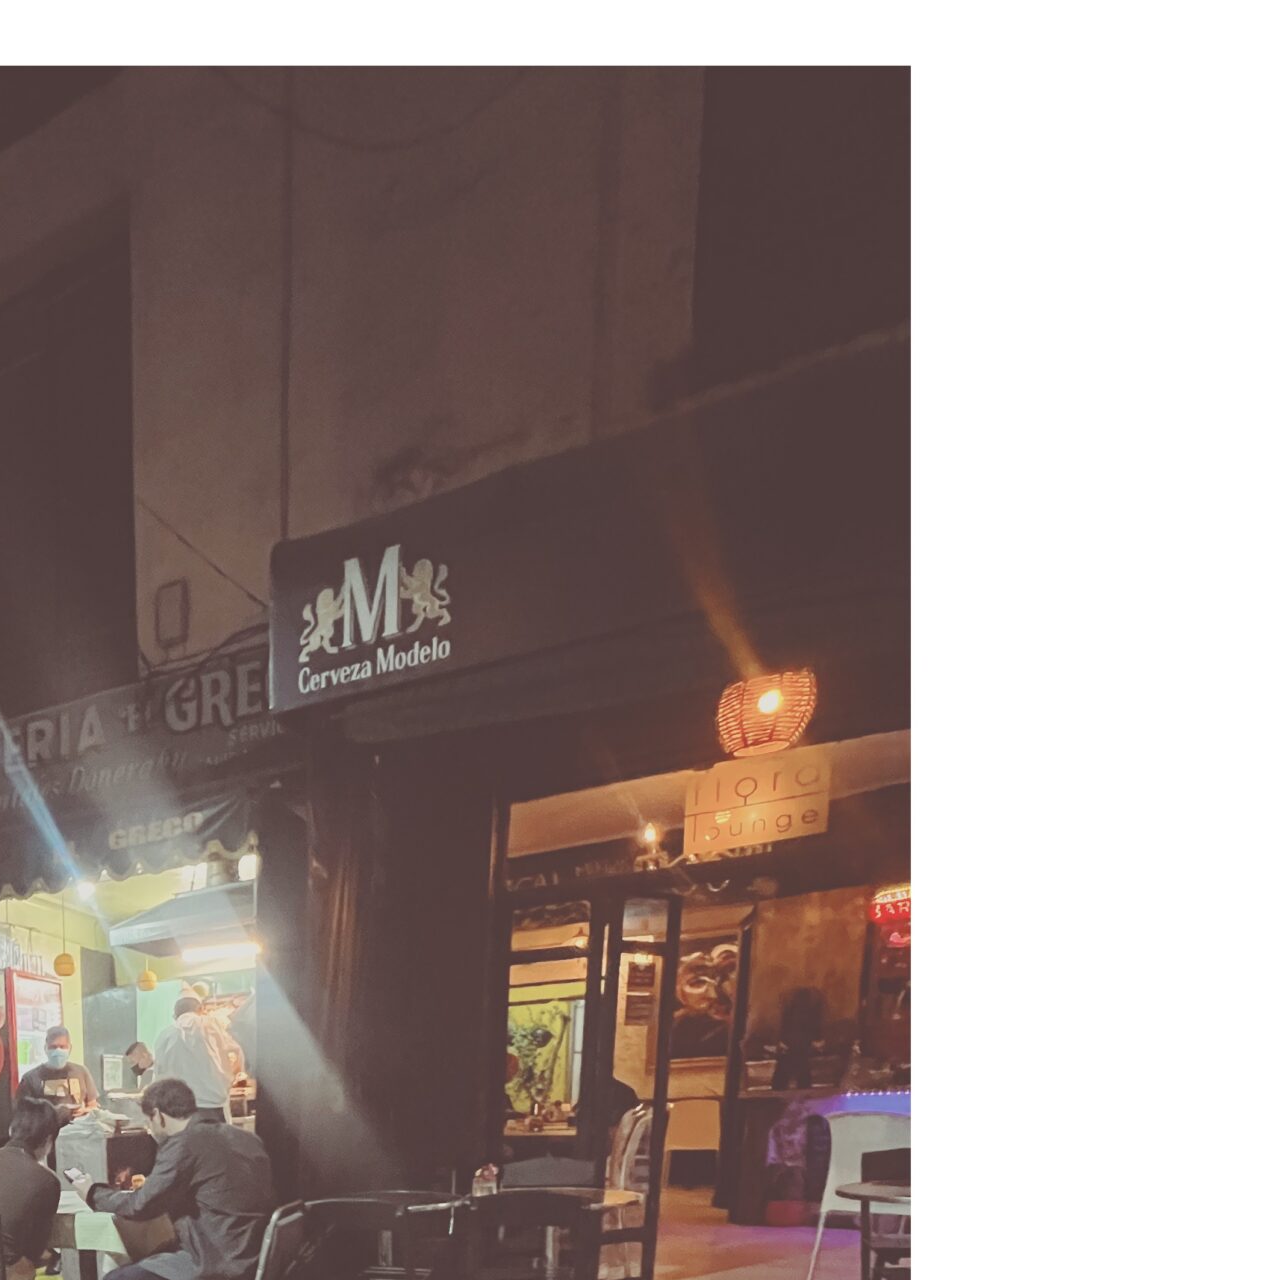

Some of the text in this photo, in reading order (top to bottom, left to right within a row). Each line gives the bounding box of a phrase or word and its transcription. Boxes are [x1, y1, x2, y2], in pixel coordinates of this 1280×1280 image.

[342, 544, 401, 648] M
[298, 636, 451, 694] Cerveza Modelo
[164, 660, 269, 732] GRE
[108, 811, 204, 850] GRECO
[692, 808, 820, 843] lounge
